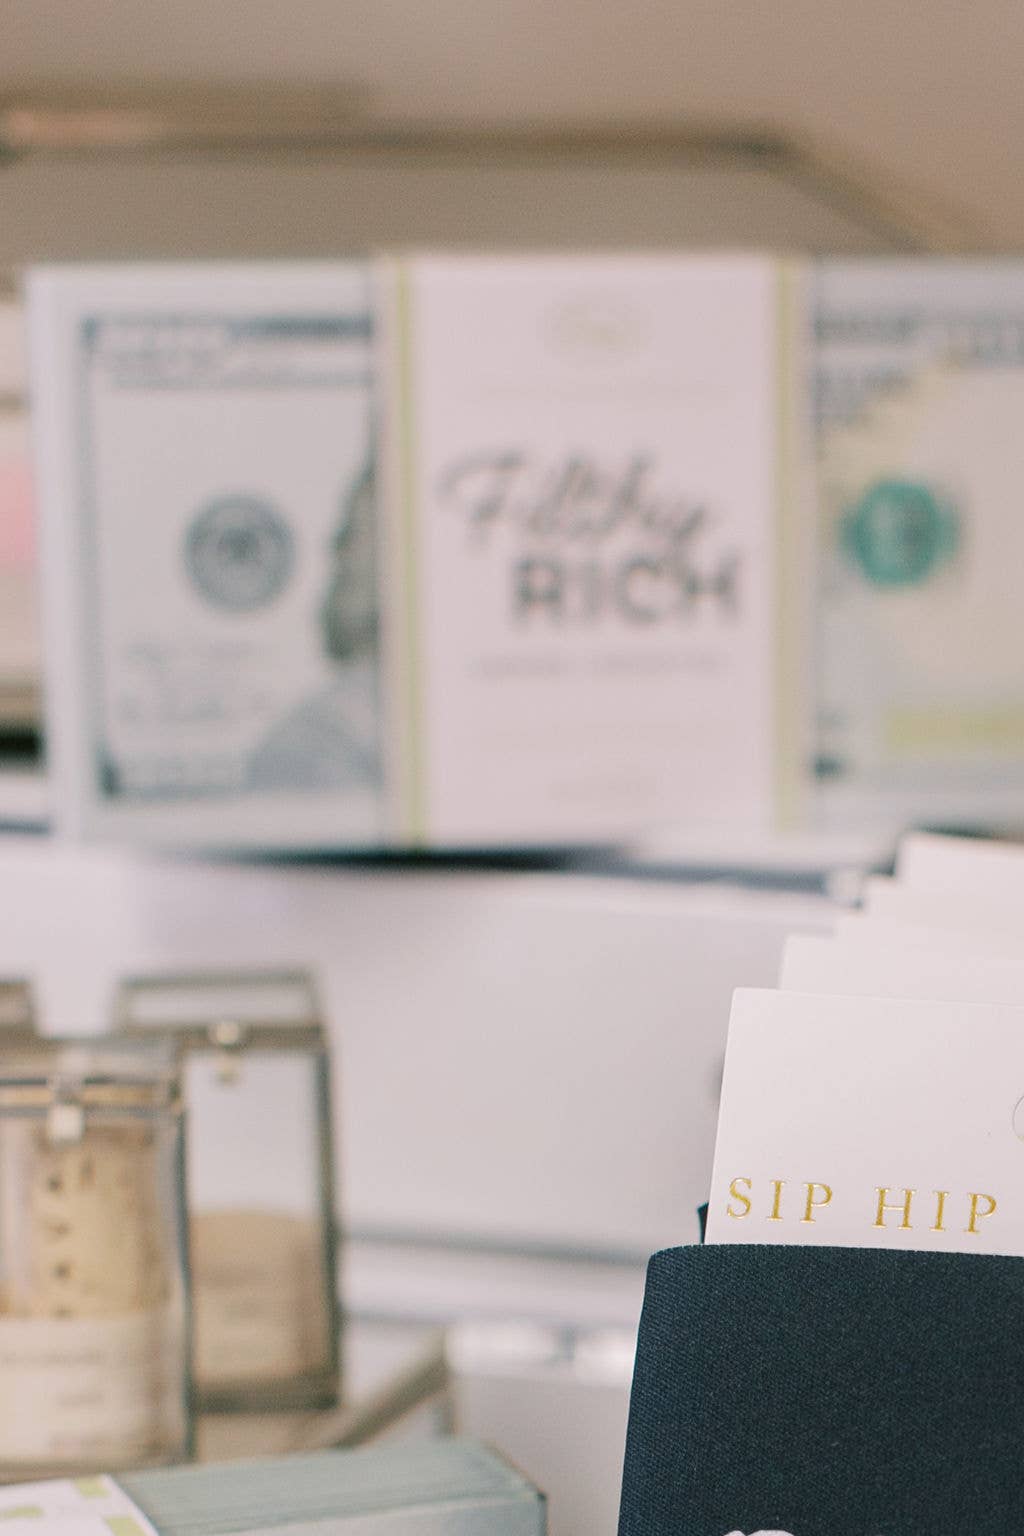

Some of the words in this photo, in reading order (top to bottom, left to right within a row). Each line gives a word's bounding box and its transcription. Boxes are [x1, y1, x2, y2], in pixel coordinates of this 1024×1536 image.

[511, 551, 742, 627] RICH
[726, 1177, 833, 1225] SIP
[873, 1186, 998, 1235] HIP
